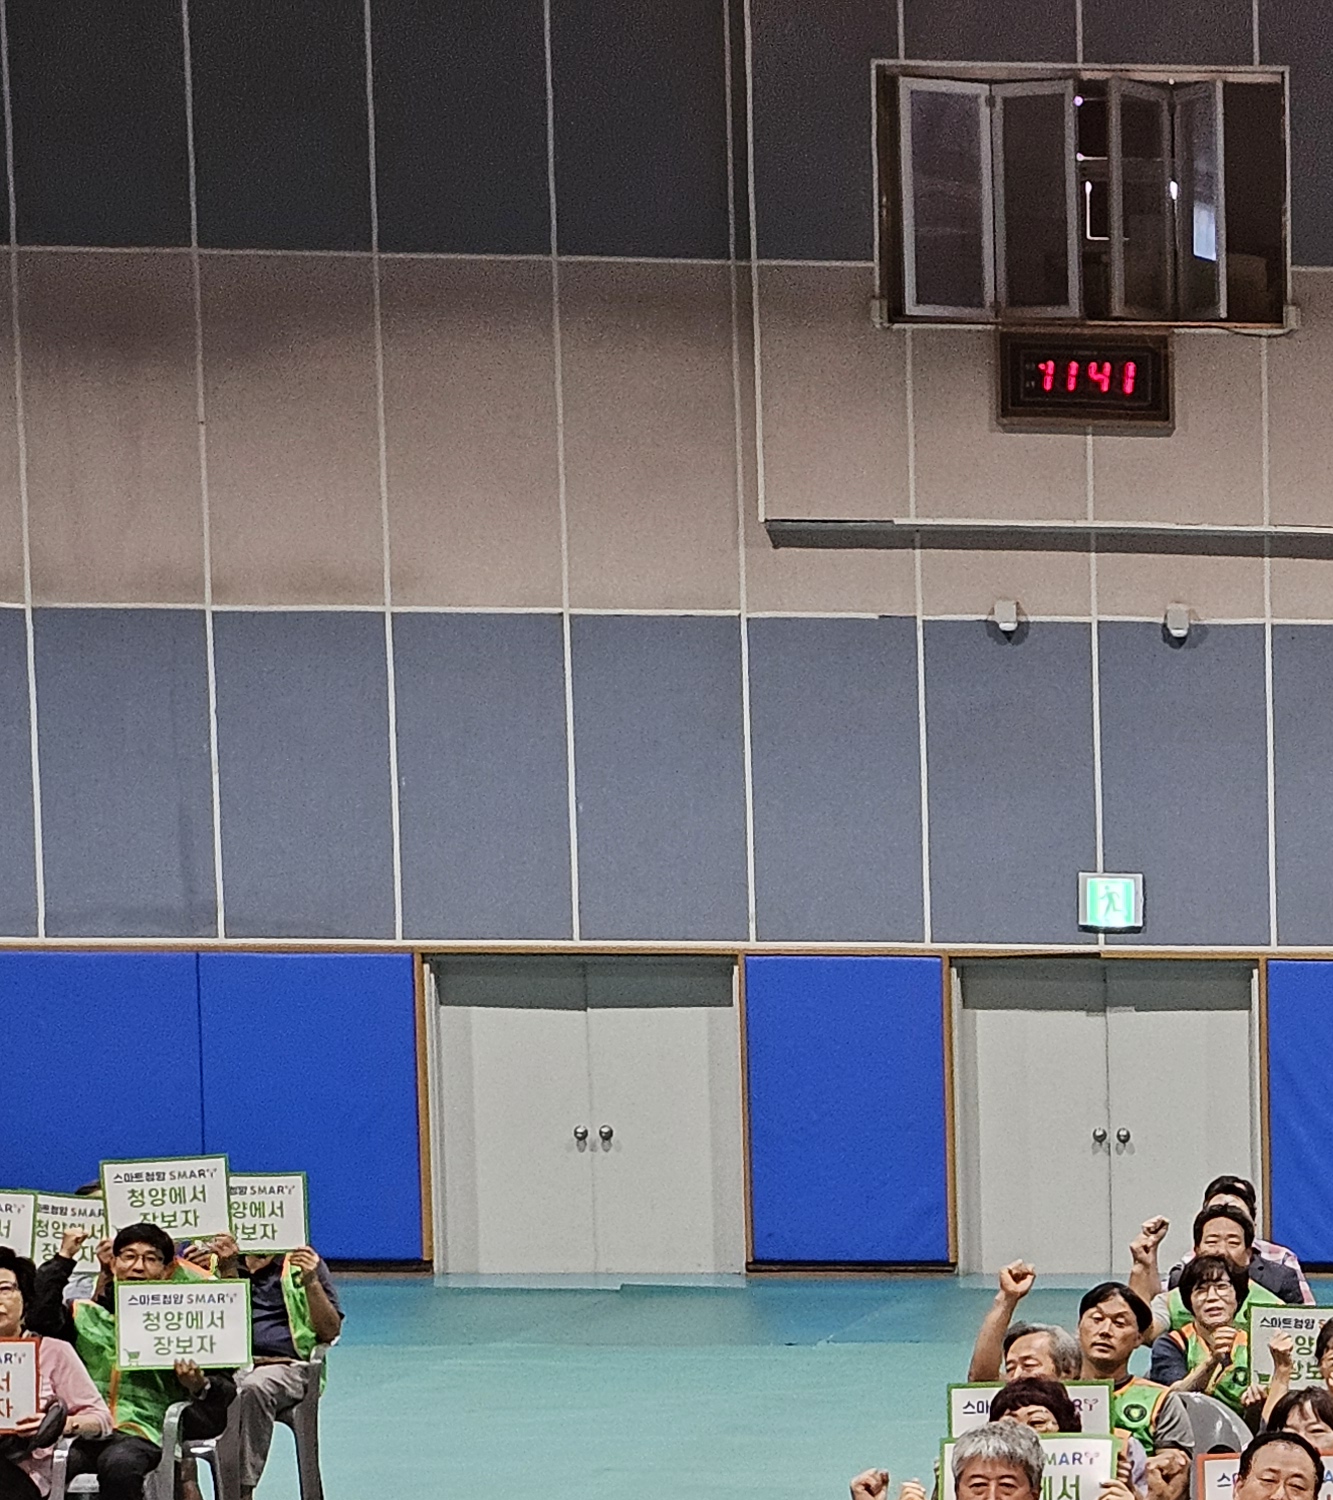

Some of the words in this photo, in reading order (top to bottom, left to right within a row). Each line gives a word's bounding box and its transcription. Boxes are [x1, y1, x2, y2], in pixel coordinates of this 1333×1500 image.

[126, 1184, 208, 1208] 청양에서
[231, 1201, 285, 1219] 양에서
[41, 1242, 97, 1264] 장자
[142, 1310, 226, 1332] 청양에서
[153, 1334, 217, 1355] 장보자
